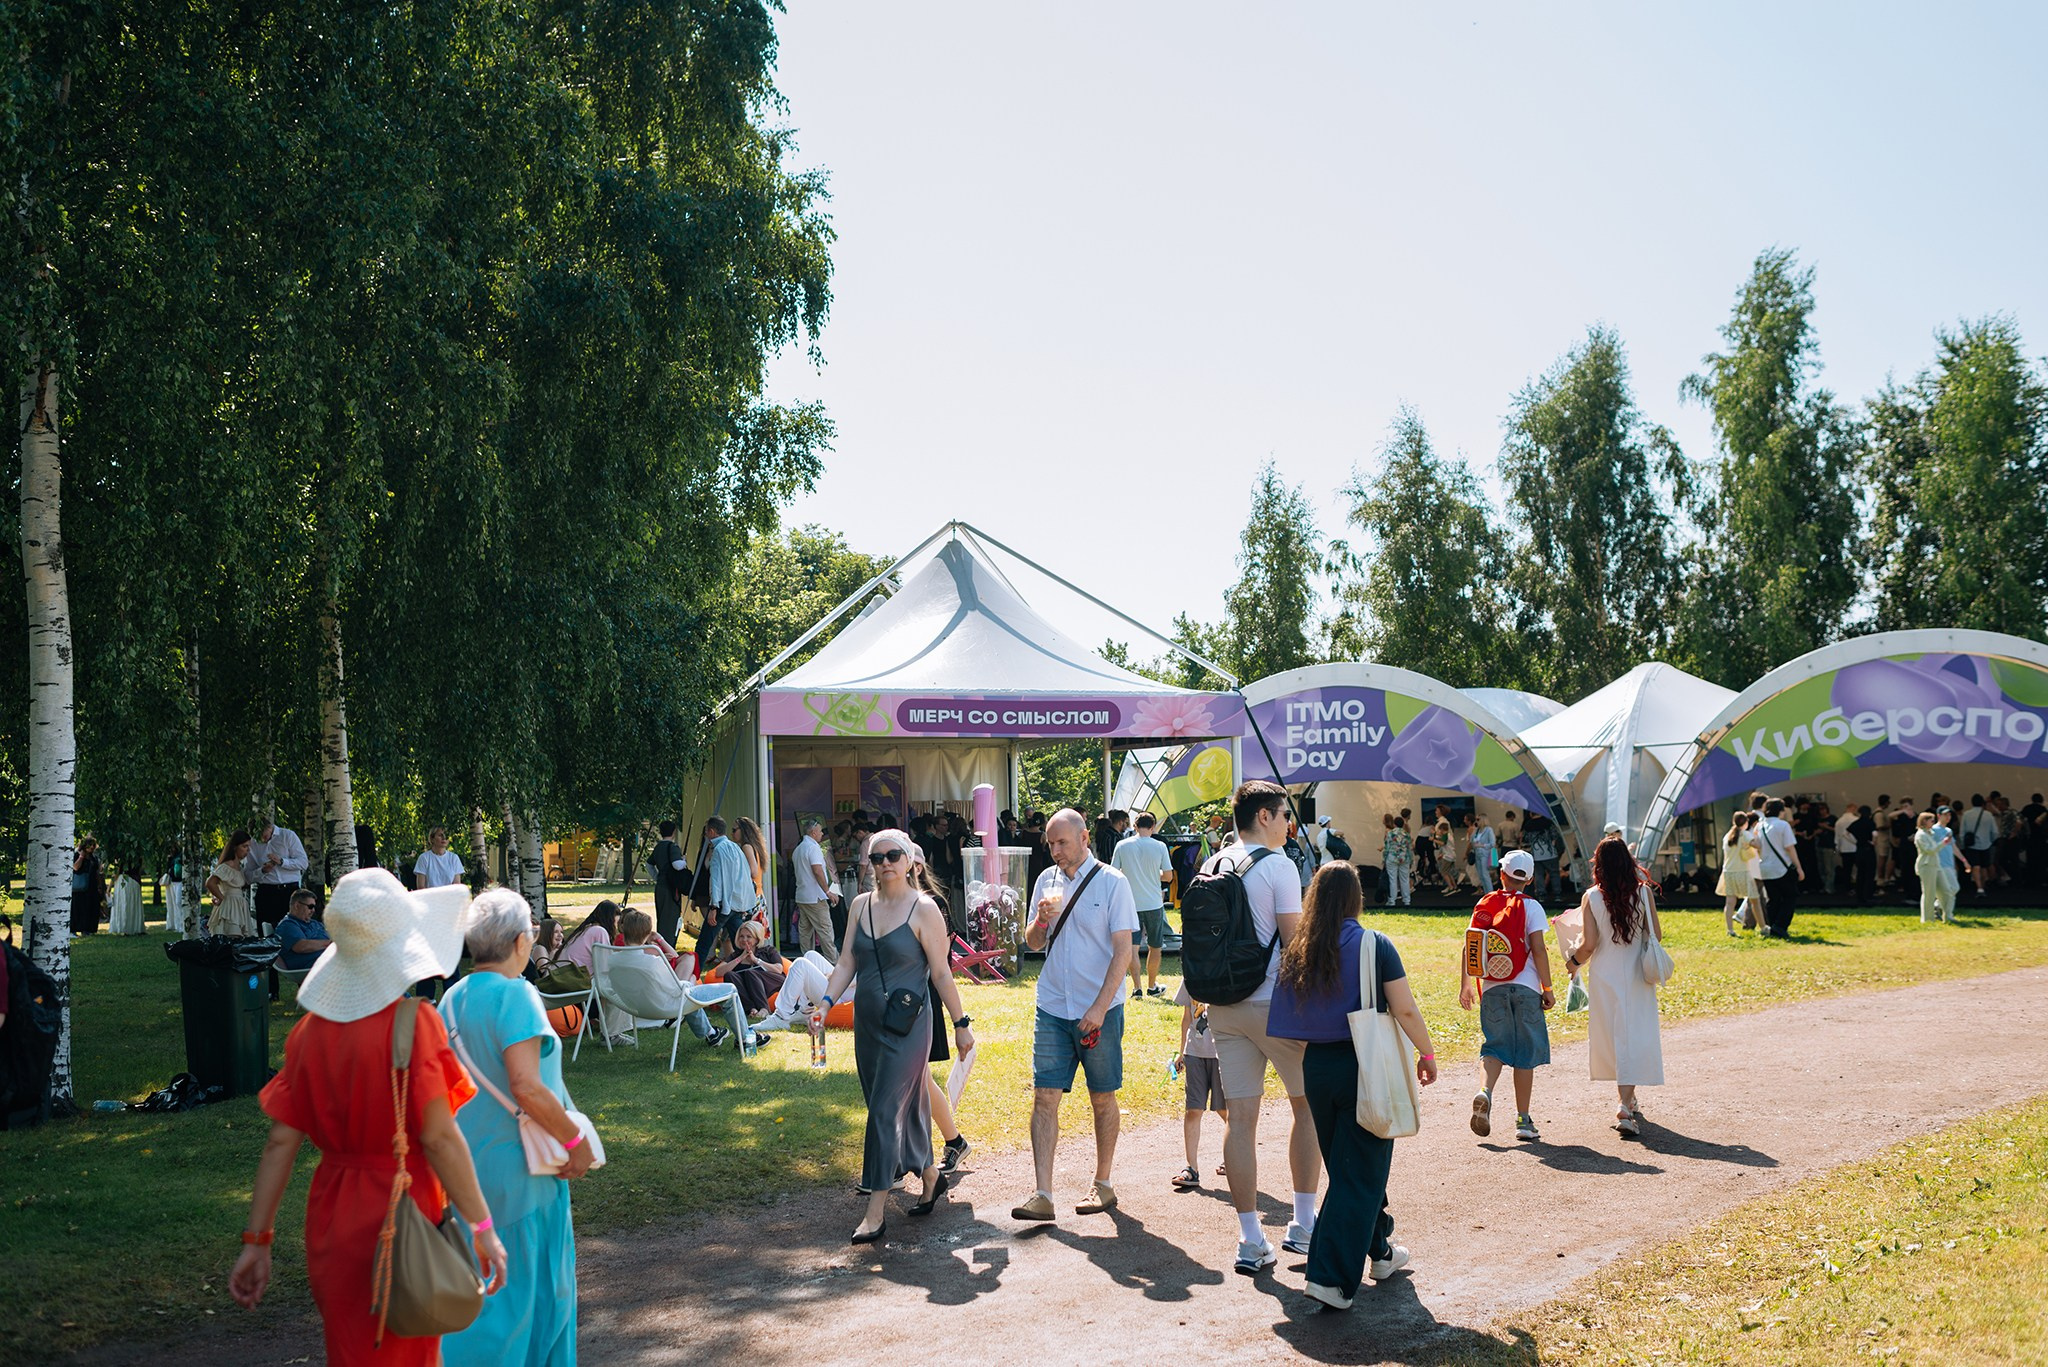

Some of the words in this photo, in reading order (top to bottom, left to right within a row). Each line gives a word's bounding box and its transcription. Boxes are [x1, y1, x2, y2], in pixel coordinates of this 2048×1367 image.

[908, 709, 963, 724] МЕРЧ
[967, 710, 998, 725] СО
[1002, 710, 1110, 725] СМЫСЛОМ
[1286, 699, 1366, 723] ITMO
[1286, 721, 1387, 747] Family
[1731, 706, 2048, 772] Киберспо
[1286, 748, 1347, 772] Day
[1476, 912, 1491, 922] LEGO
[1469, 940, 1478, 968] TICKET
